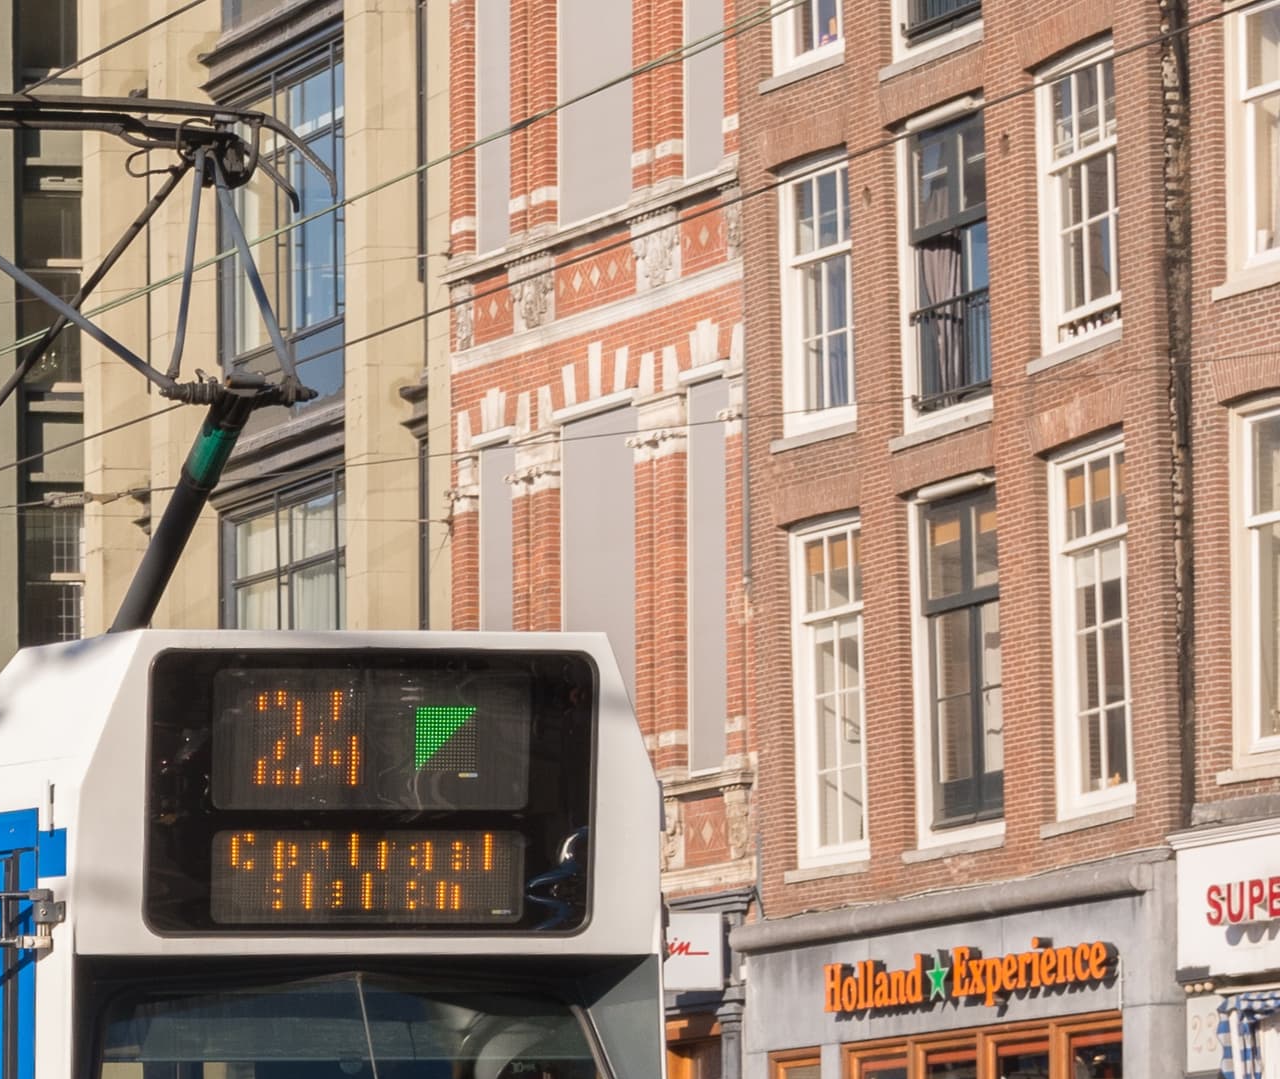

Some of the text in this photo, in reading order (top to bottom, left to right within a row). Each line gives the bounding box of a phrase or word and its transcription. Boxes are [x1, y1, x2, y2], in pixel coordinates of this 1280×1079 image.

[254, 687, 361, 786] 24
[824, 936, 1107, 1013] Holland Experience
